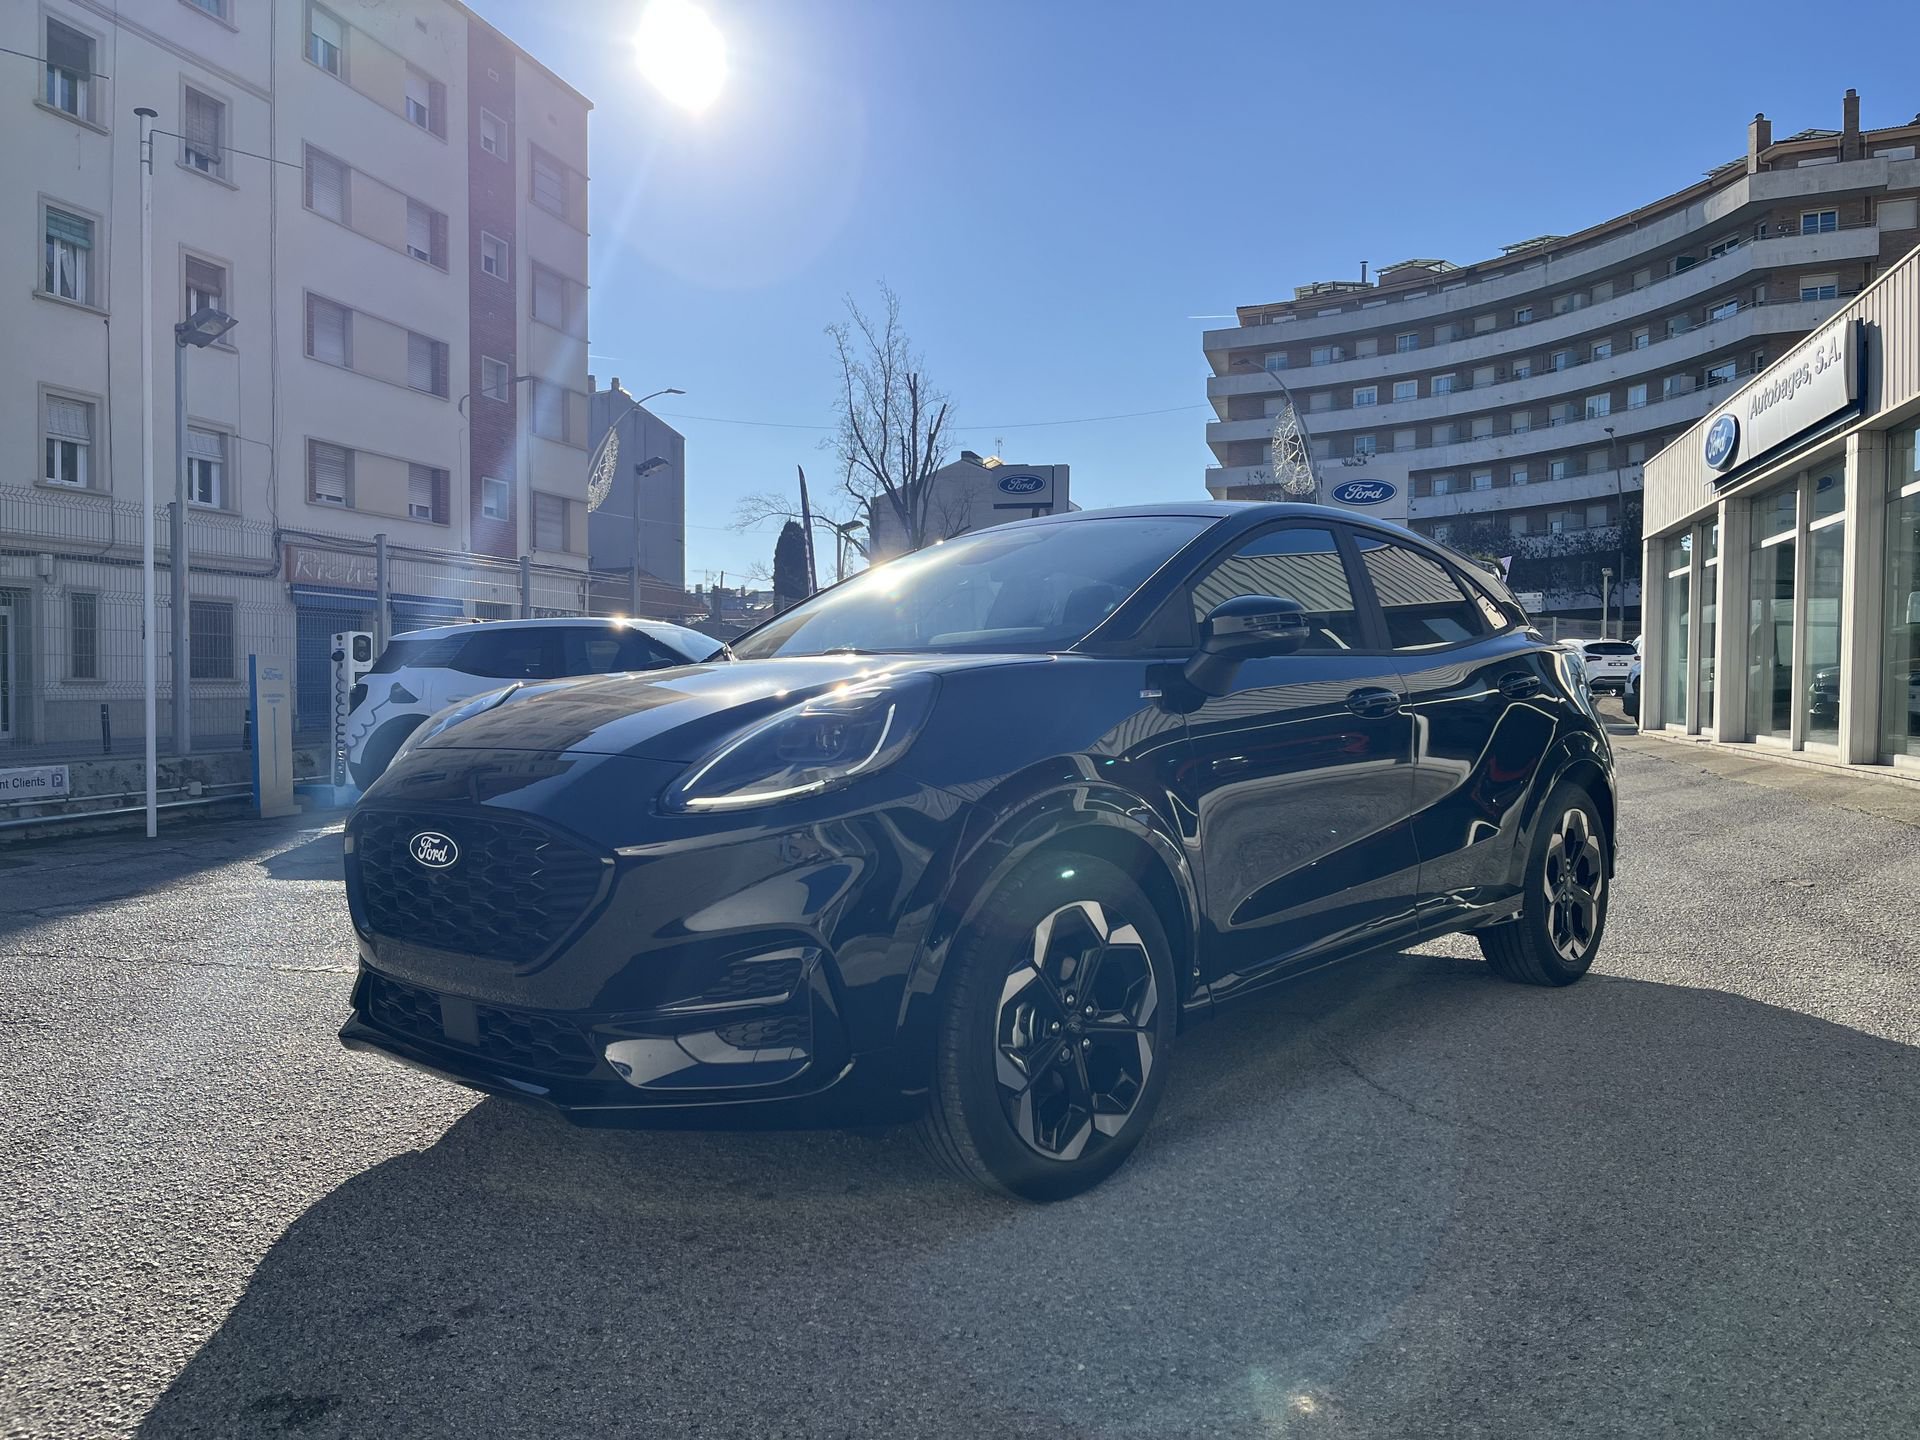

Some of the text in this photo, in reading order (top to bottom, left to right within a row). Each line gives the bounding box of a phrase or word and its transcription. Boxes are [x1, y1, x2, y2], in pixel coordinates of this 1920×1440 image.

[1750, 336, 1842, 420] Autobages, S.A.
[1707, 422, 1729, 459] Ford
[1007, 477, 1036, 490] Ford
[1344, 483, 1384, 500] Ford
[12, 776, 46, 789] Clients
[417, 835, 448, 863] Ford
